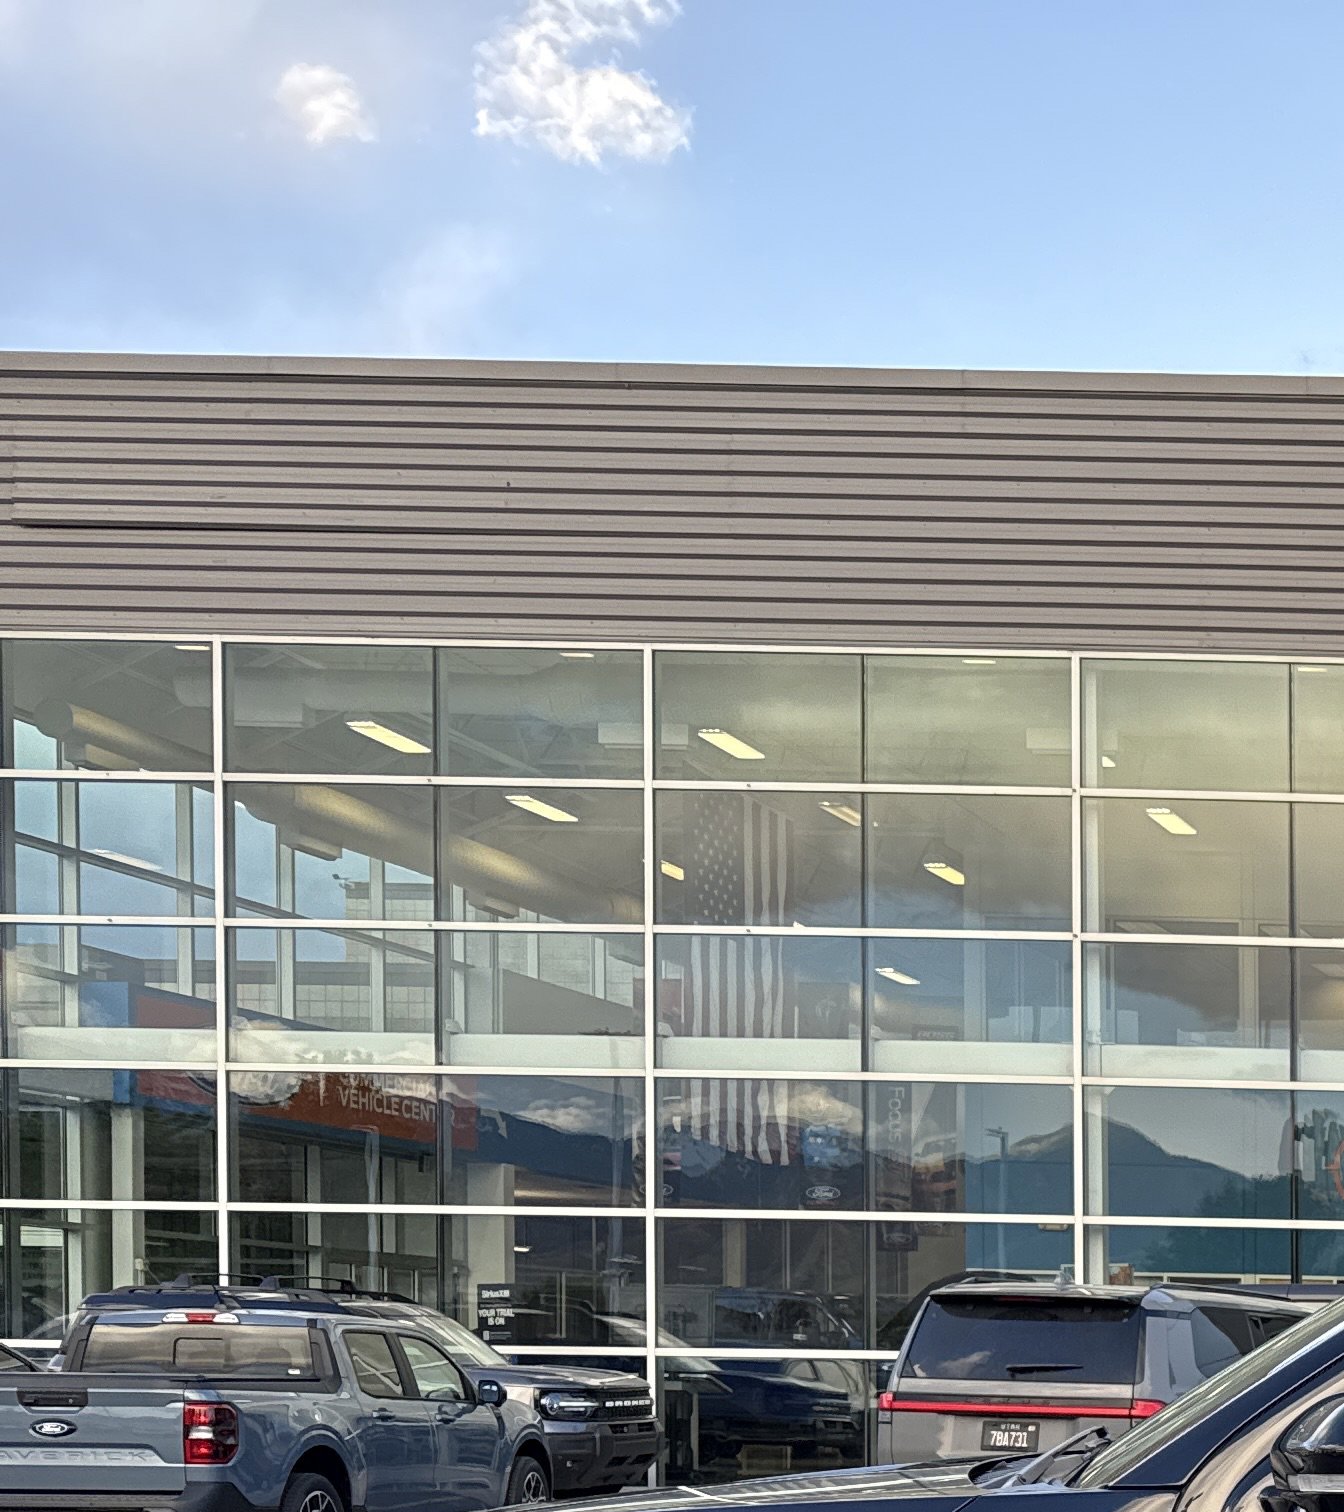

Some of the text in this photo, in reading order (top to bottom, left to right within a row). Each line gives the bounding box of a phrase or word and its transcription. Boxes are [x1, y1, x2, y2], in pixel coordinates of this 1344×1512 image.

[336, 1086, 455, 1127] VEHICLE CENTR
[478, 1308, 515, 1318] YOUR TRIAL
[494, 1317, 505, 1326] ON
